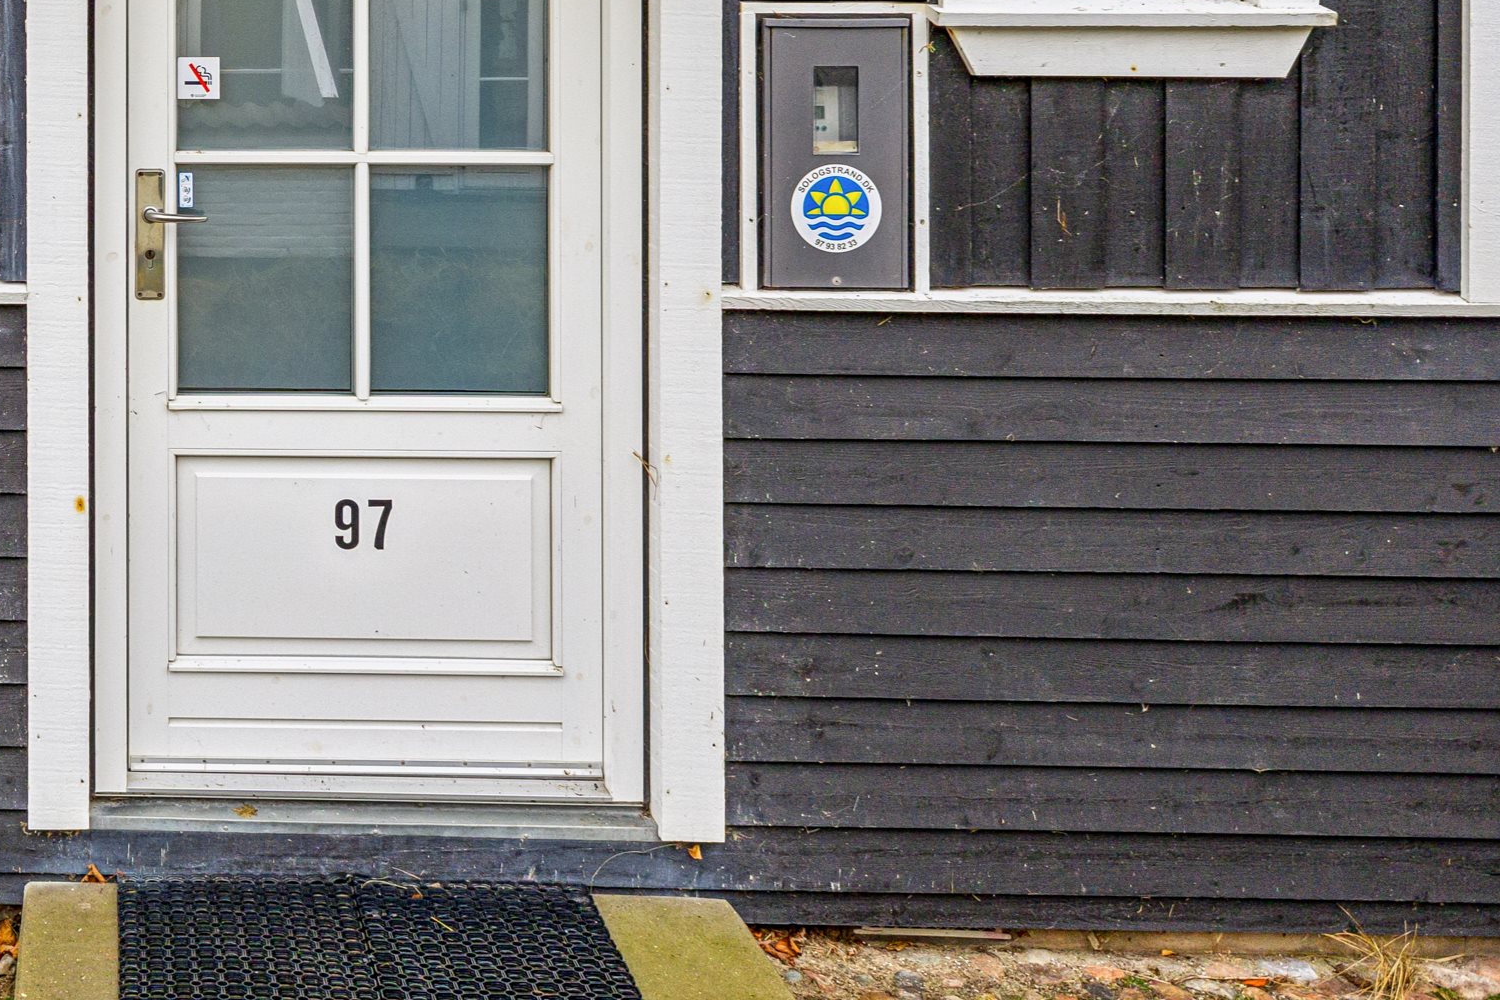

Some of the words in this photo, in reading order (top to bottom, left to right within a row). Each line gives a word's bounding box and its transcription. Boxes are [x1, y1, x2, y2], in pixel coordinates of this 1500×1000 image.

[798, 166, 875, 193] SOLOGSTRAND.DK
[814, 239, 824, 248] 97
[826, 242, 835, 250] 93
[837, 242, 846, 250] 82
[848, 239, 858, 248] 33
[334, 498, 392, 550] 97
